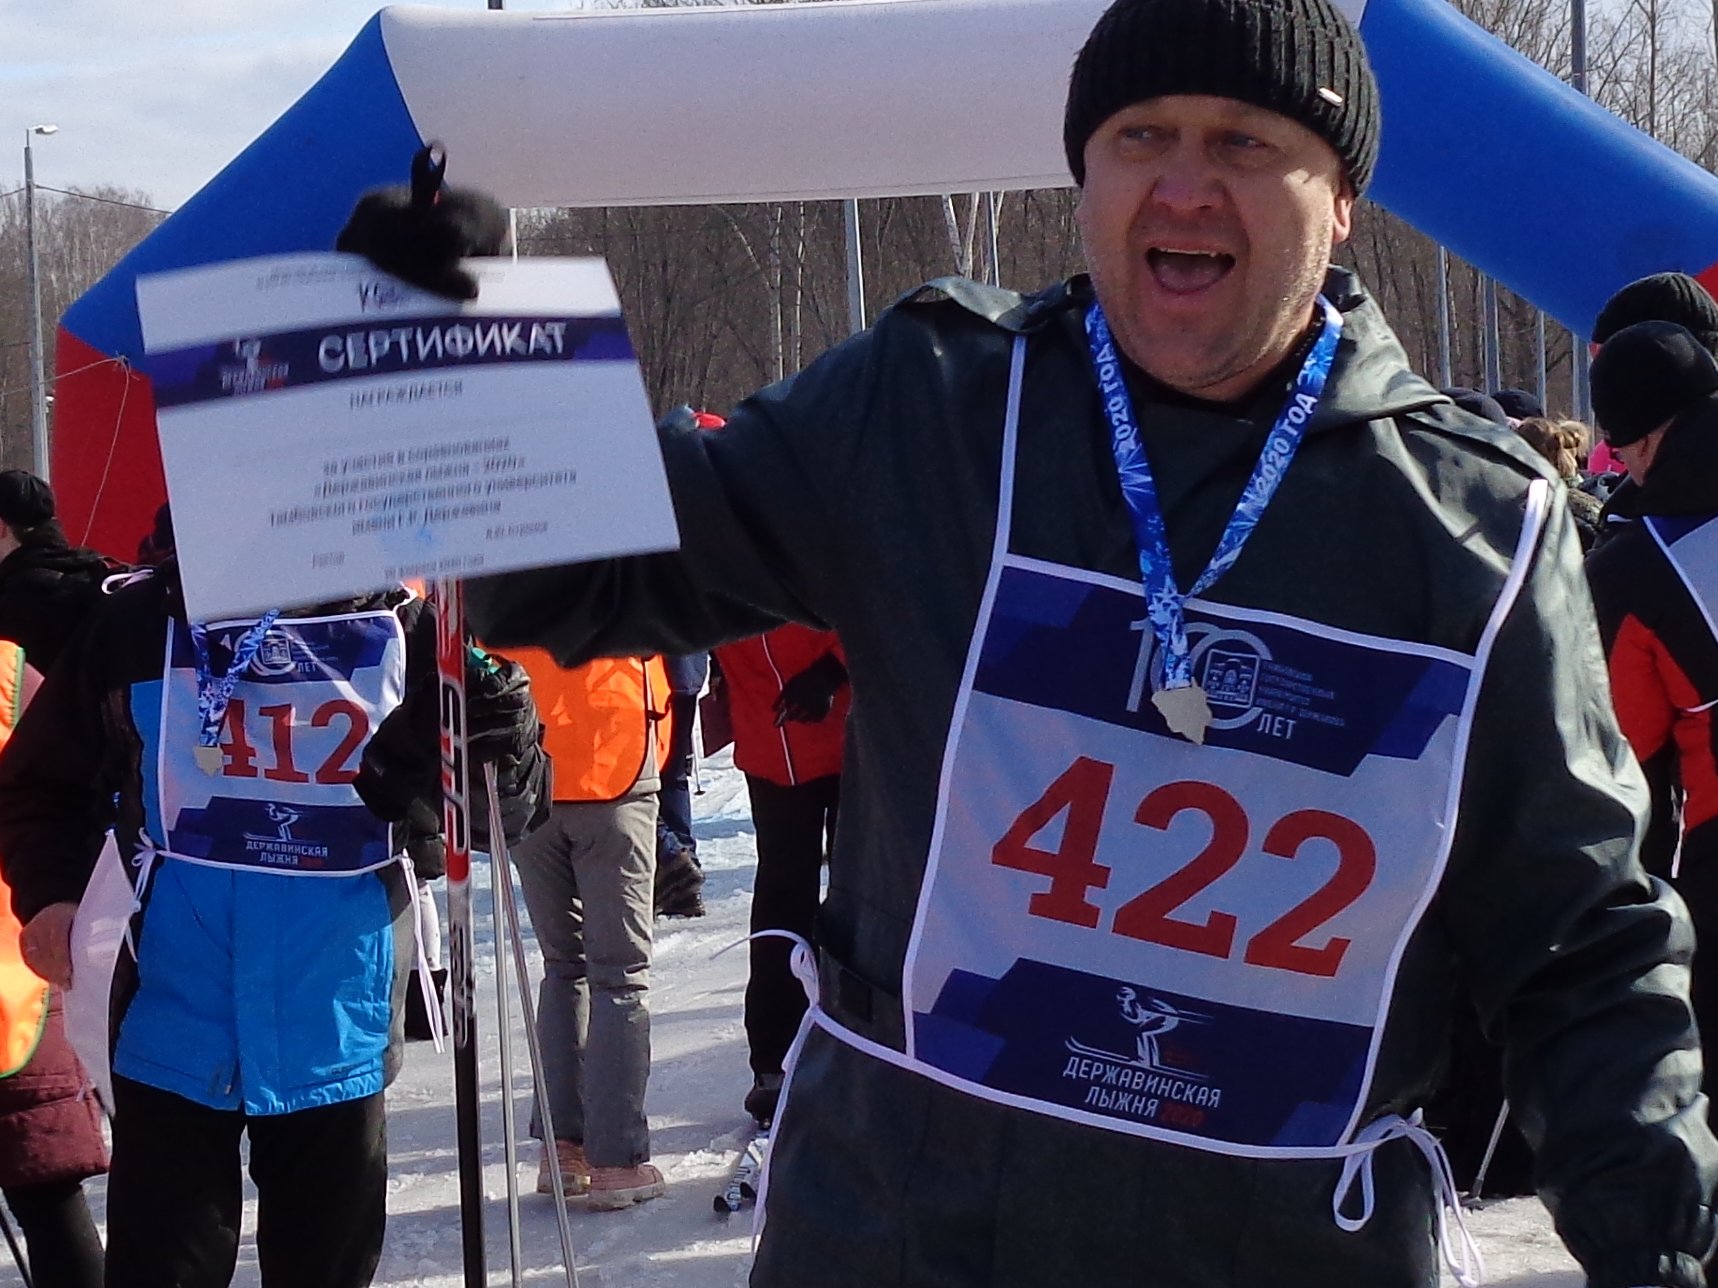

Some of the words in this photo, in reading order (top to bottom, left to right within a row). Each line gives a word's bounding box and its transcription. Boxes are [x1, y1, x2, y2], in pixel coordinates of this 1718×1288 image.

[317, 321, 567, 374] СЕРТИФИКАТ
[1095, 342, 1119, 394] ГОД
[1255, 437, 1291, 502] 2020
[1281, 392, 1319, 437] ГОД
[217, 698, 370, 786] 412
[1256, 713, 1297, 740] ЛЕТ
[245, 839, 329, 857] ДЕРЖАВИНСКАЯ
[990, 755, 1377, 978] 422
[1062, 1056, 1222, 1108] ДЕРЖАВИНСКАЯ
[1084, 1086, 1160, 1118] ЛЫЖНЯ
